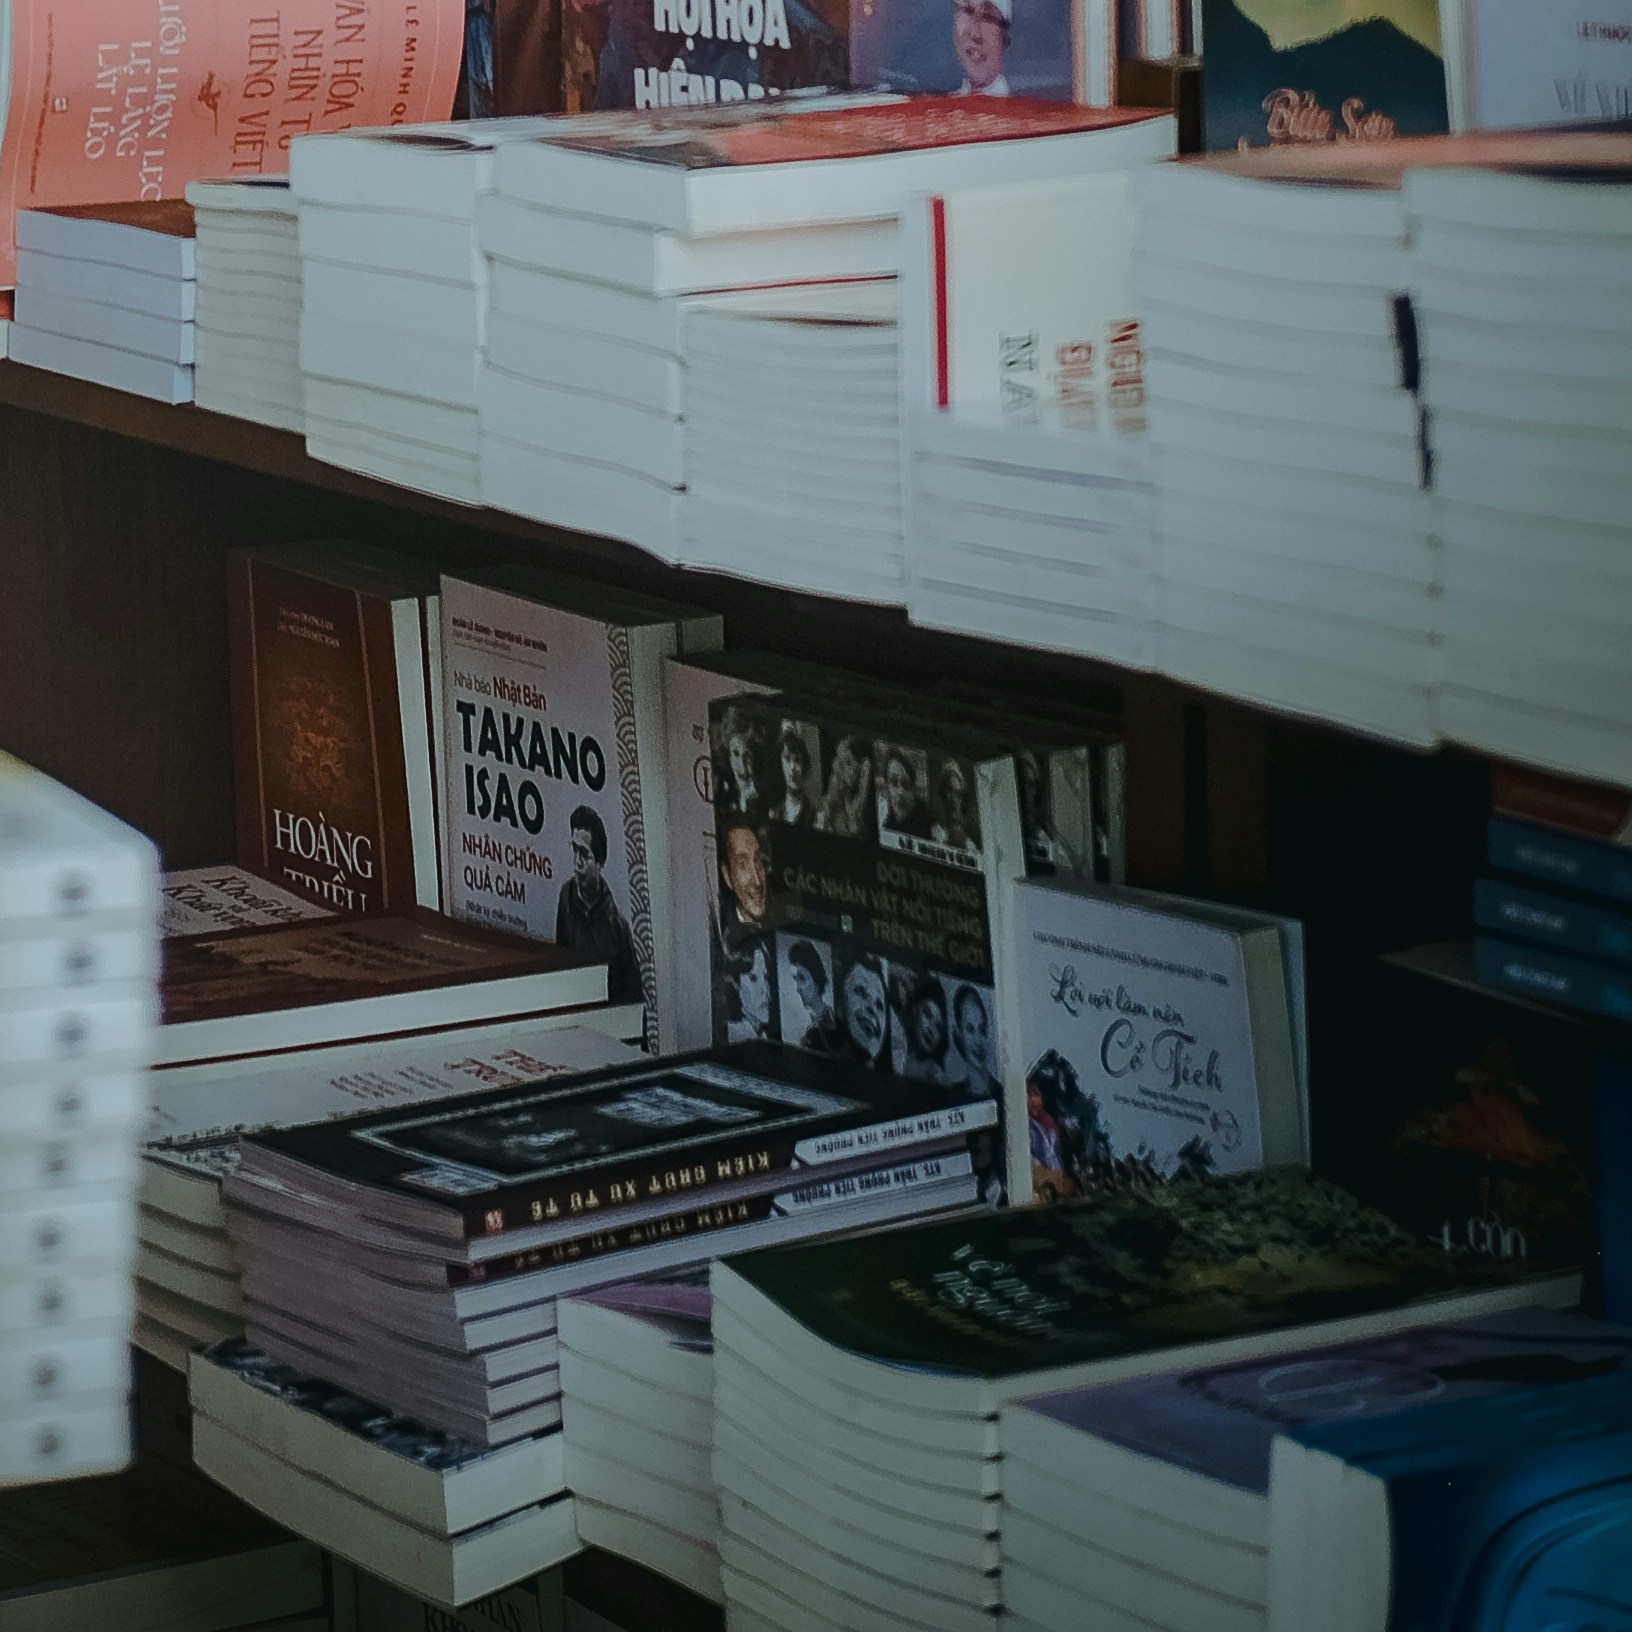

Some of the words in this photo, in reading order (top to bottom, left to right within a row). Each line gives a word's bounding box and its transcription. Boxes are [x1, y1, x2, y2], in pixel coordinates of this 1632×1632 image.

[405, 4, 419, 29] LÊ
[243, 9, 288, 100] TIẾNG
[284, 27, 327, 104] NHÌN
[398, 36, 418, 95] MINH
[321, 57, 365, 119] HÓA
[229, 109, 271, 174] VIỆT
[493, 675, 522, 708] Nhật
[523, 683, 547, 712] Bản
[455, 699, 607, 793] TAKANO
[464, 763, 545, 836] ISAO
[272, 809, 374, 880] HOÀNG
[461, 831, 503, 864] NHÂN
[504, 844, 553, 880] CHỨNG
[463, 863, 493, 894] QUẢ
[495, 870, 526, 905] CẢM
[716, 1150, 770, 1179] KIẾM
